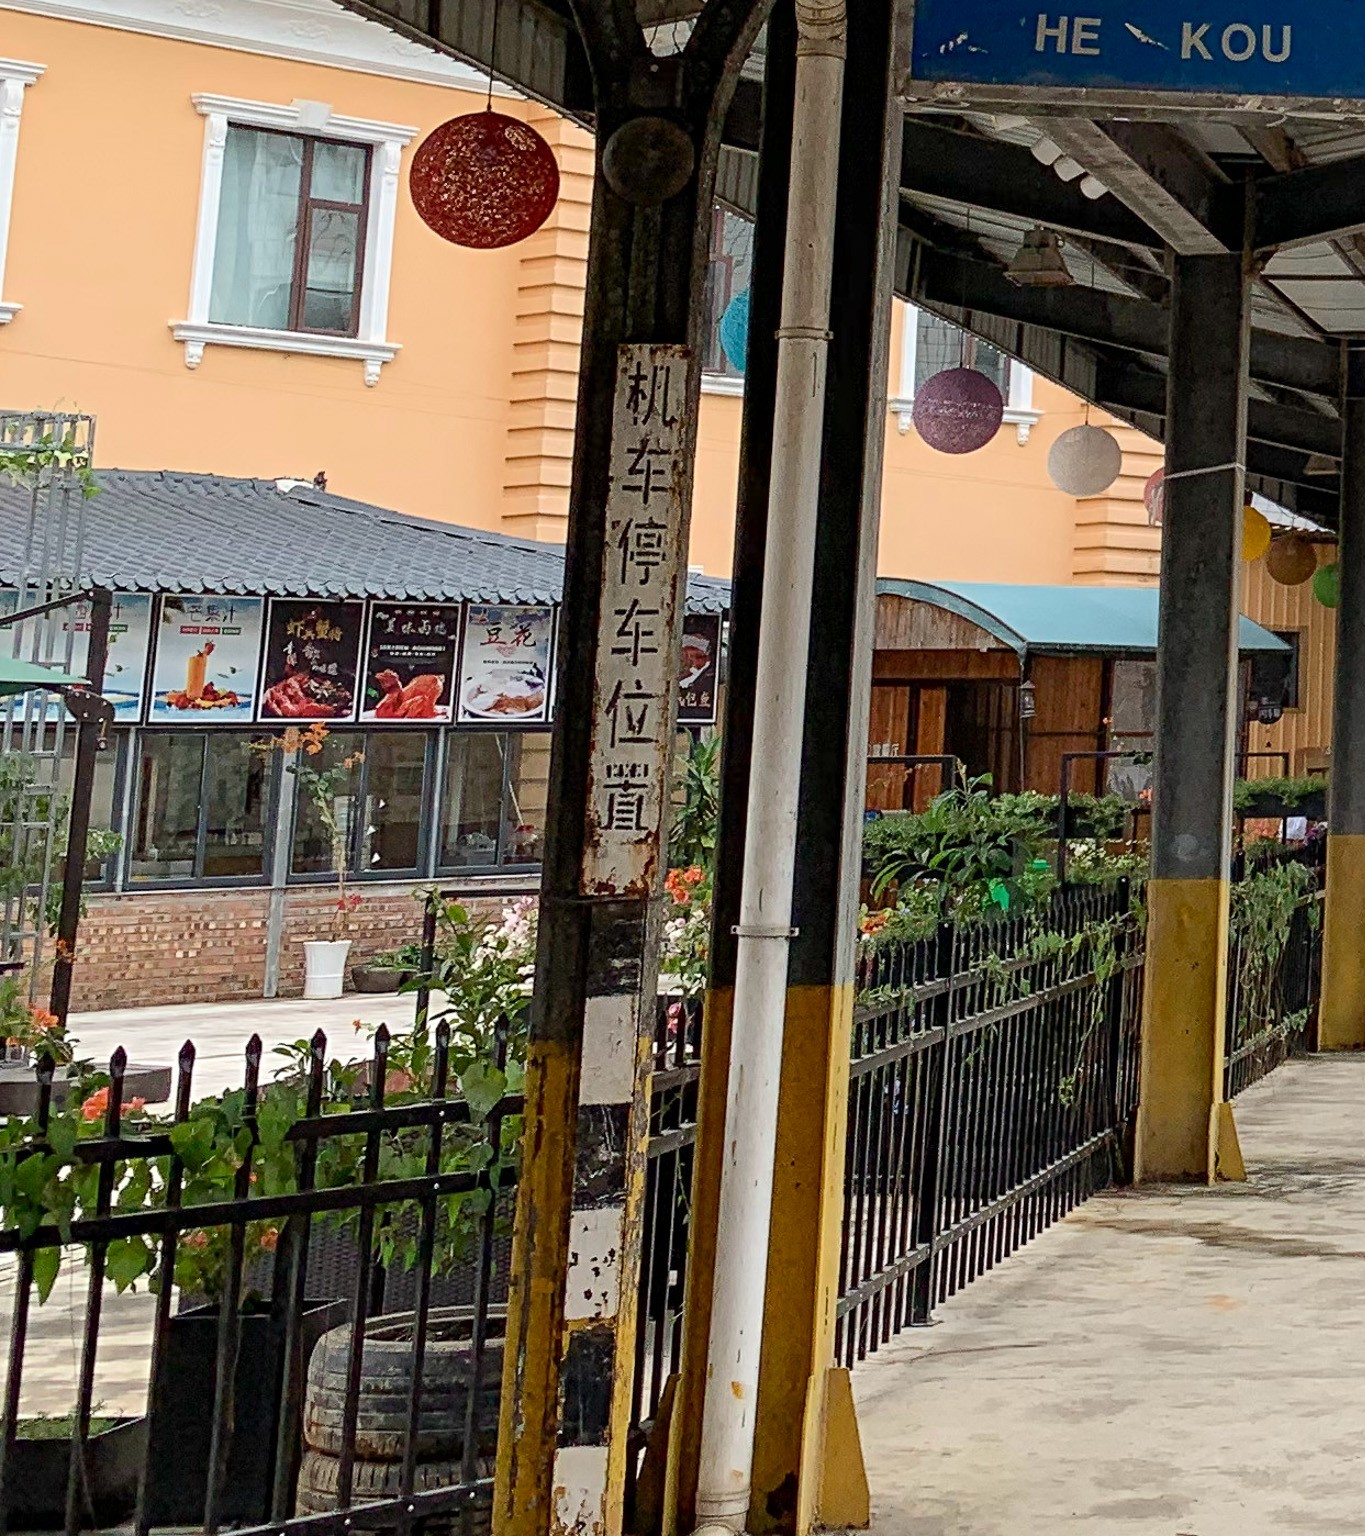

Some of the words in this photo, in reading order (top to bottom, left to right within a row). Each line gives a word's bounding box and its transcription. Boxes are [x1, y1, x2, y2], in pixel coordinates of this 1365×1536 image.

[1035, 14, 1101, 56] HE
[1181, 21, 1292, 63] KOU
[600, 360, 678, 832] 机车停车位置
[480, 621, 537, 647] 豆花
